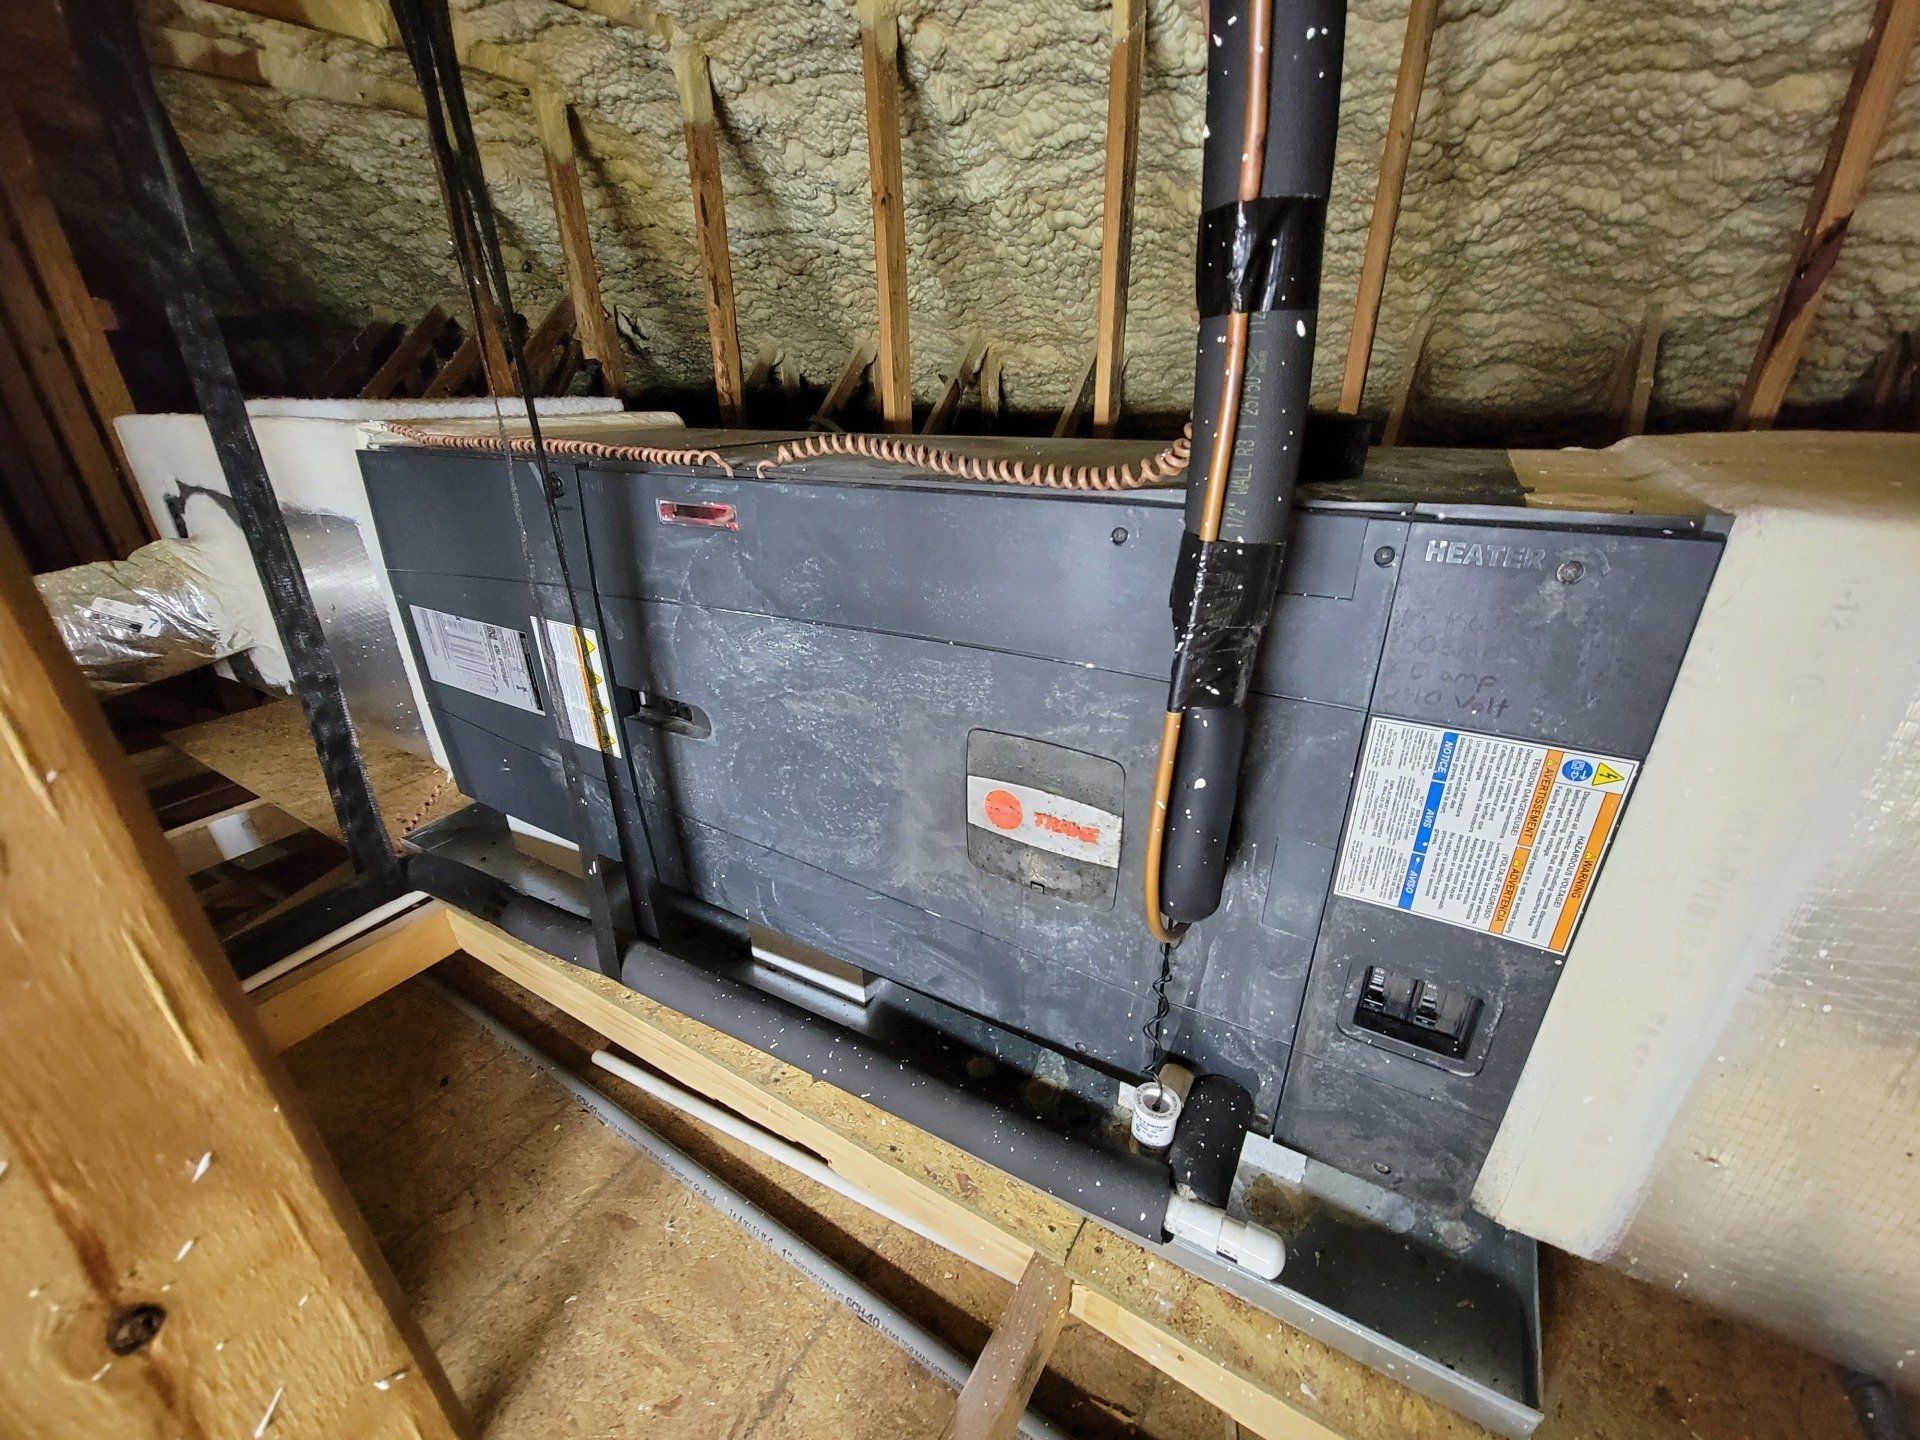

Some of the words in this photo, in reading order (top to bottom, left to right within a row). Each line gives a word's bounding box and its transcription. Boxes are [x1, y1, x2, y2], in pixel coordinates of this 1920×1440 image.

[1228, 461, 1251, 495] WALL
[1425, 539, 1547, 572] HEATER
[1441, 671, 1497, 692] amp
[1455, 693, 1509, 718] Volt
[1437, 741, 1453, 773] NOTICE
[1491, 743, 1499, 754] tous
[1525, 758, 1541, 787] TENSION
[1493, 784, 1503, 806] distance
[1513, 780, 1523, 796] toutes
[1550, 785, 1561, 804] Failure
[1569, 789, 1581, 807] before
[1523, 768, 1554, 838] AVERTISSEMENT
[1555, 787, 1572, 818] discharged
[1573, 791, 1590, 822] Disconnect
[1422, 808, 1435, 828] AVIS
[1550, 819, 1560, 836] stored
[1536, 829, 1546, 845] above
[1553, 836, 1564, 853] Insure
[1563, 830, 1575, 850] electric
[1531, 845, 1540, 860] could
[1549, 854, 1557, 864] that
[1555, 850, 1566, 866] power
[1564, 835, 1585, 876] HAZARDOUS
[1526, 860, 1535, 874] result
[1404, 870, 1418, 894] AVISO
[1519, 881, 1528, 894] dath
[1541, 872, 1551, 887] motor
[1547, 867, 1561, 891] including
[1570, 860, 1592, 899] WARNING
[1494, 868, 1520, 922] ADVERTENCIA
[1530, 888, 1545, 913] capacitors
[1542, 892, 1552, 909] remote
[1552, 877, 1570, 907] VOLTAGE!
[1510, 902, 1520, 919] serious
[1527, 914, 1536, 926] have
[1531, 910, 1546, 939] disconnects
